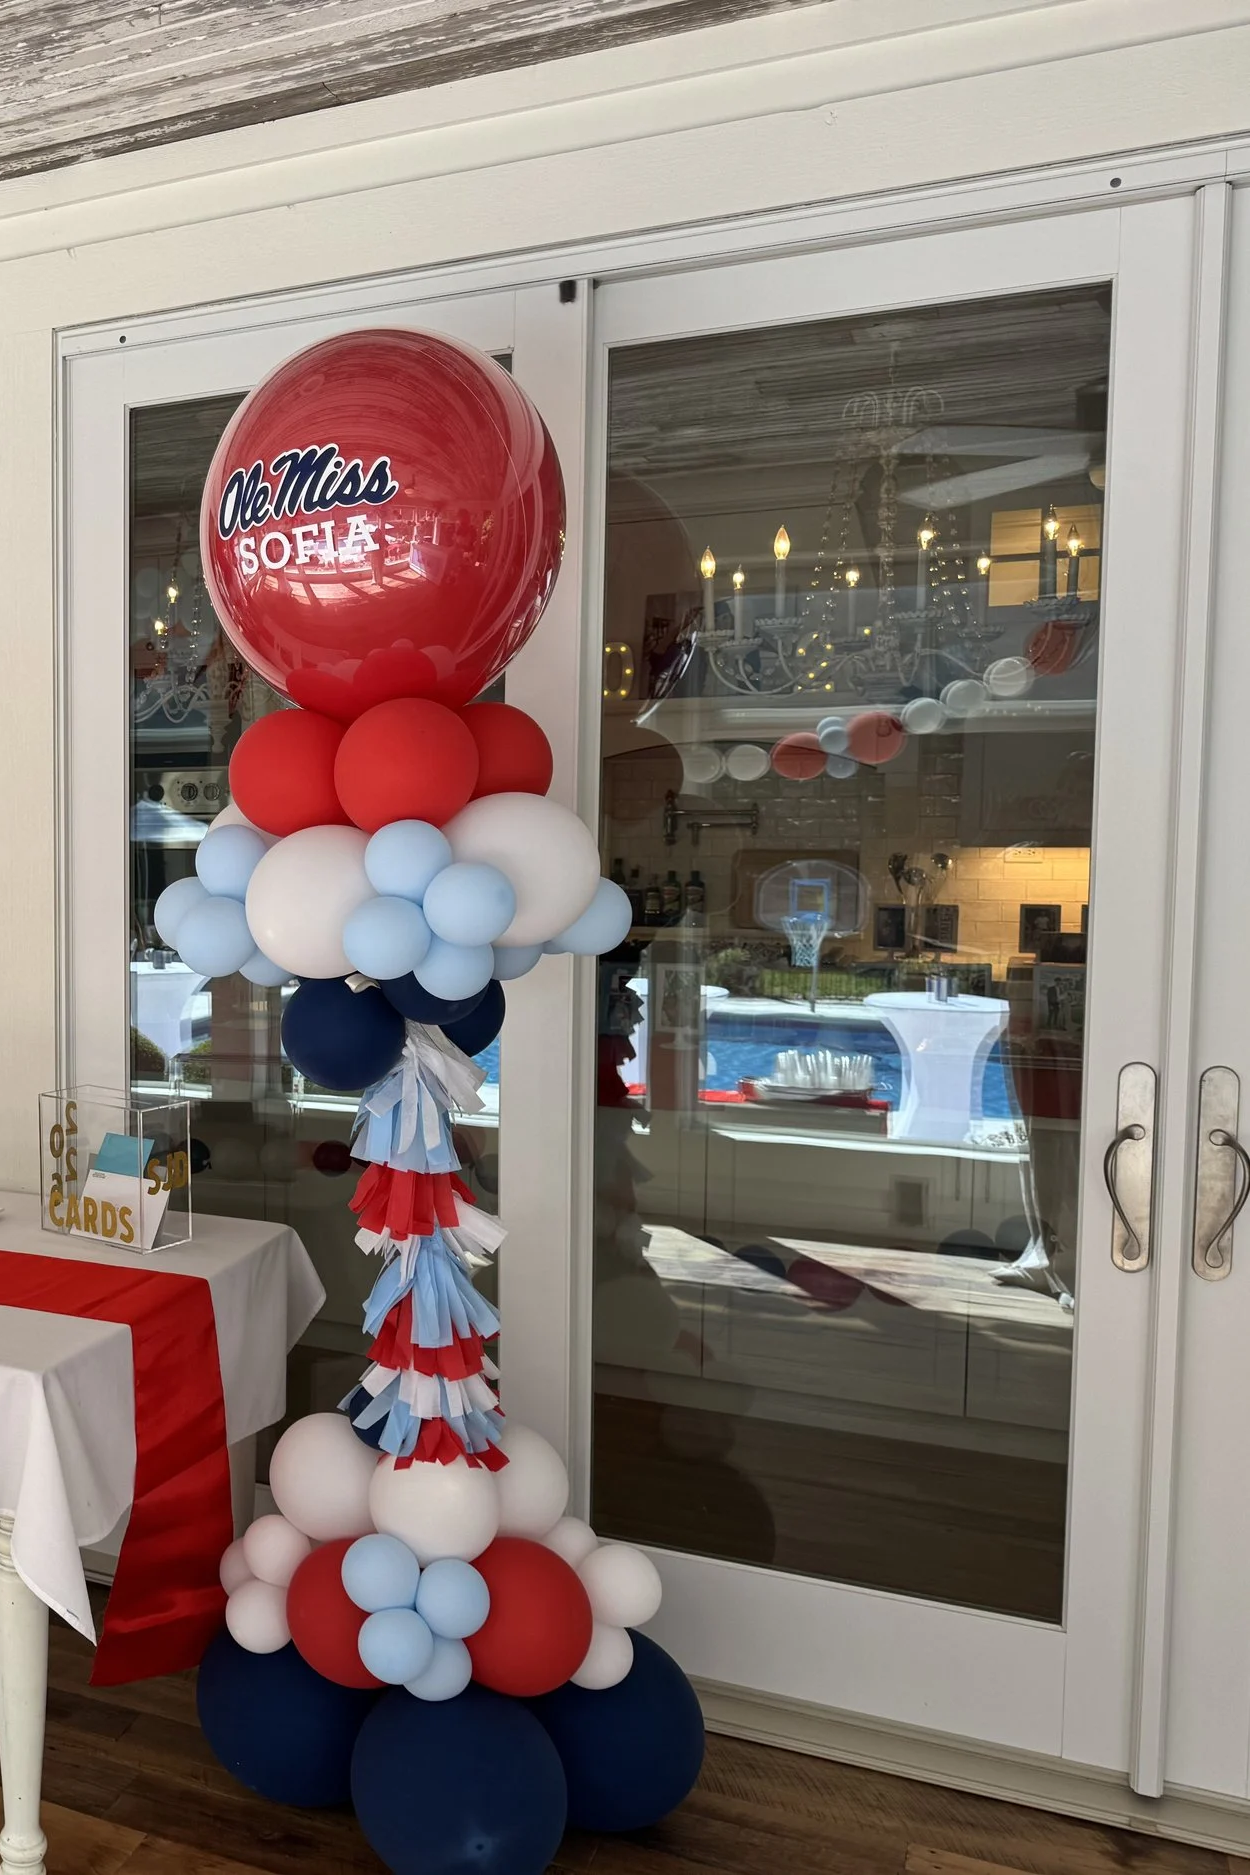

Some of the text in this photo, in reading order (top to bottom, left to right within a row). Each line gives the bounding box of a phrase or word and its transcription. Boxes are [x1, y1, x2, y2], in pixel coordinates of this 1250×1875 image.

[218, 443, 399, 540] Ole Miss
[241, 514, 380, 575] SOFIA
[49, 1191, 135, 1244] CARDS
